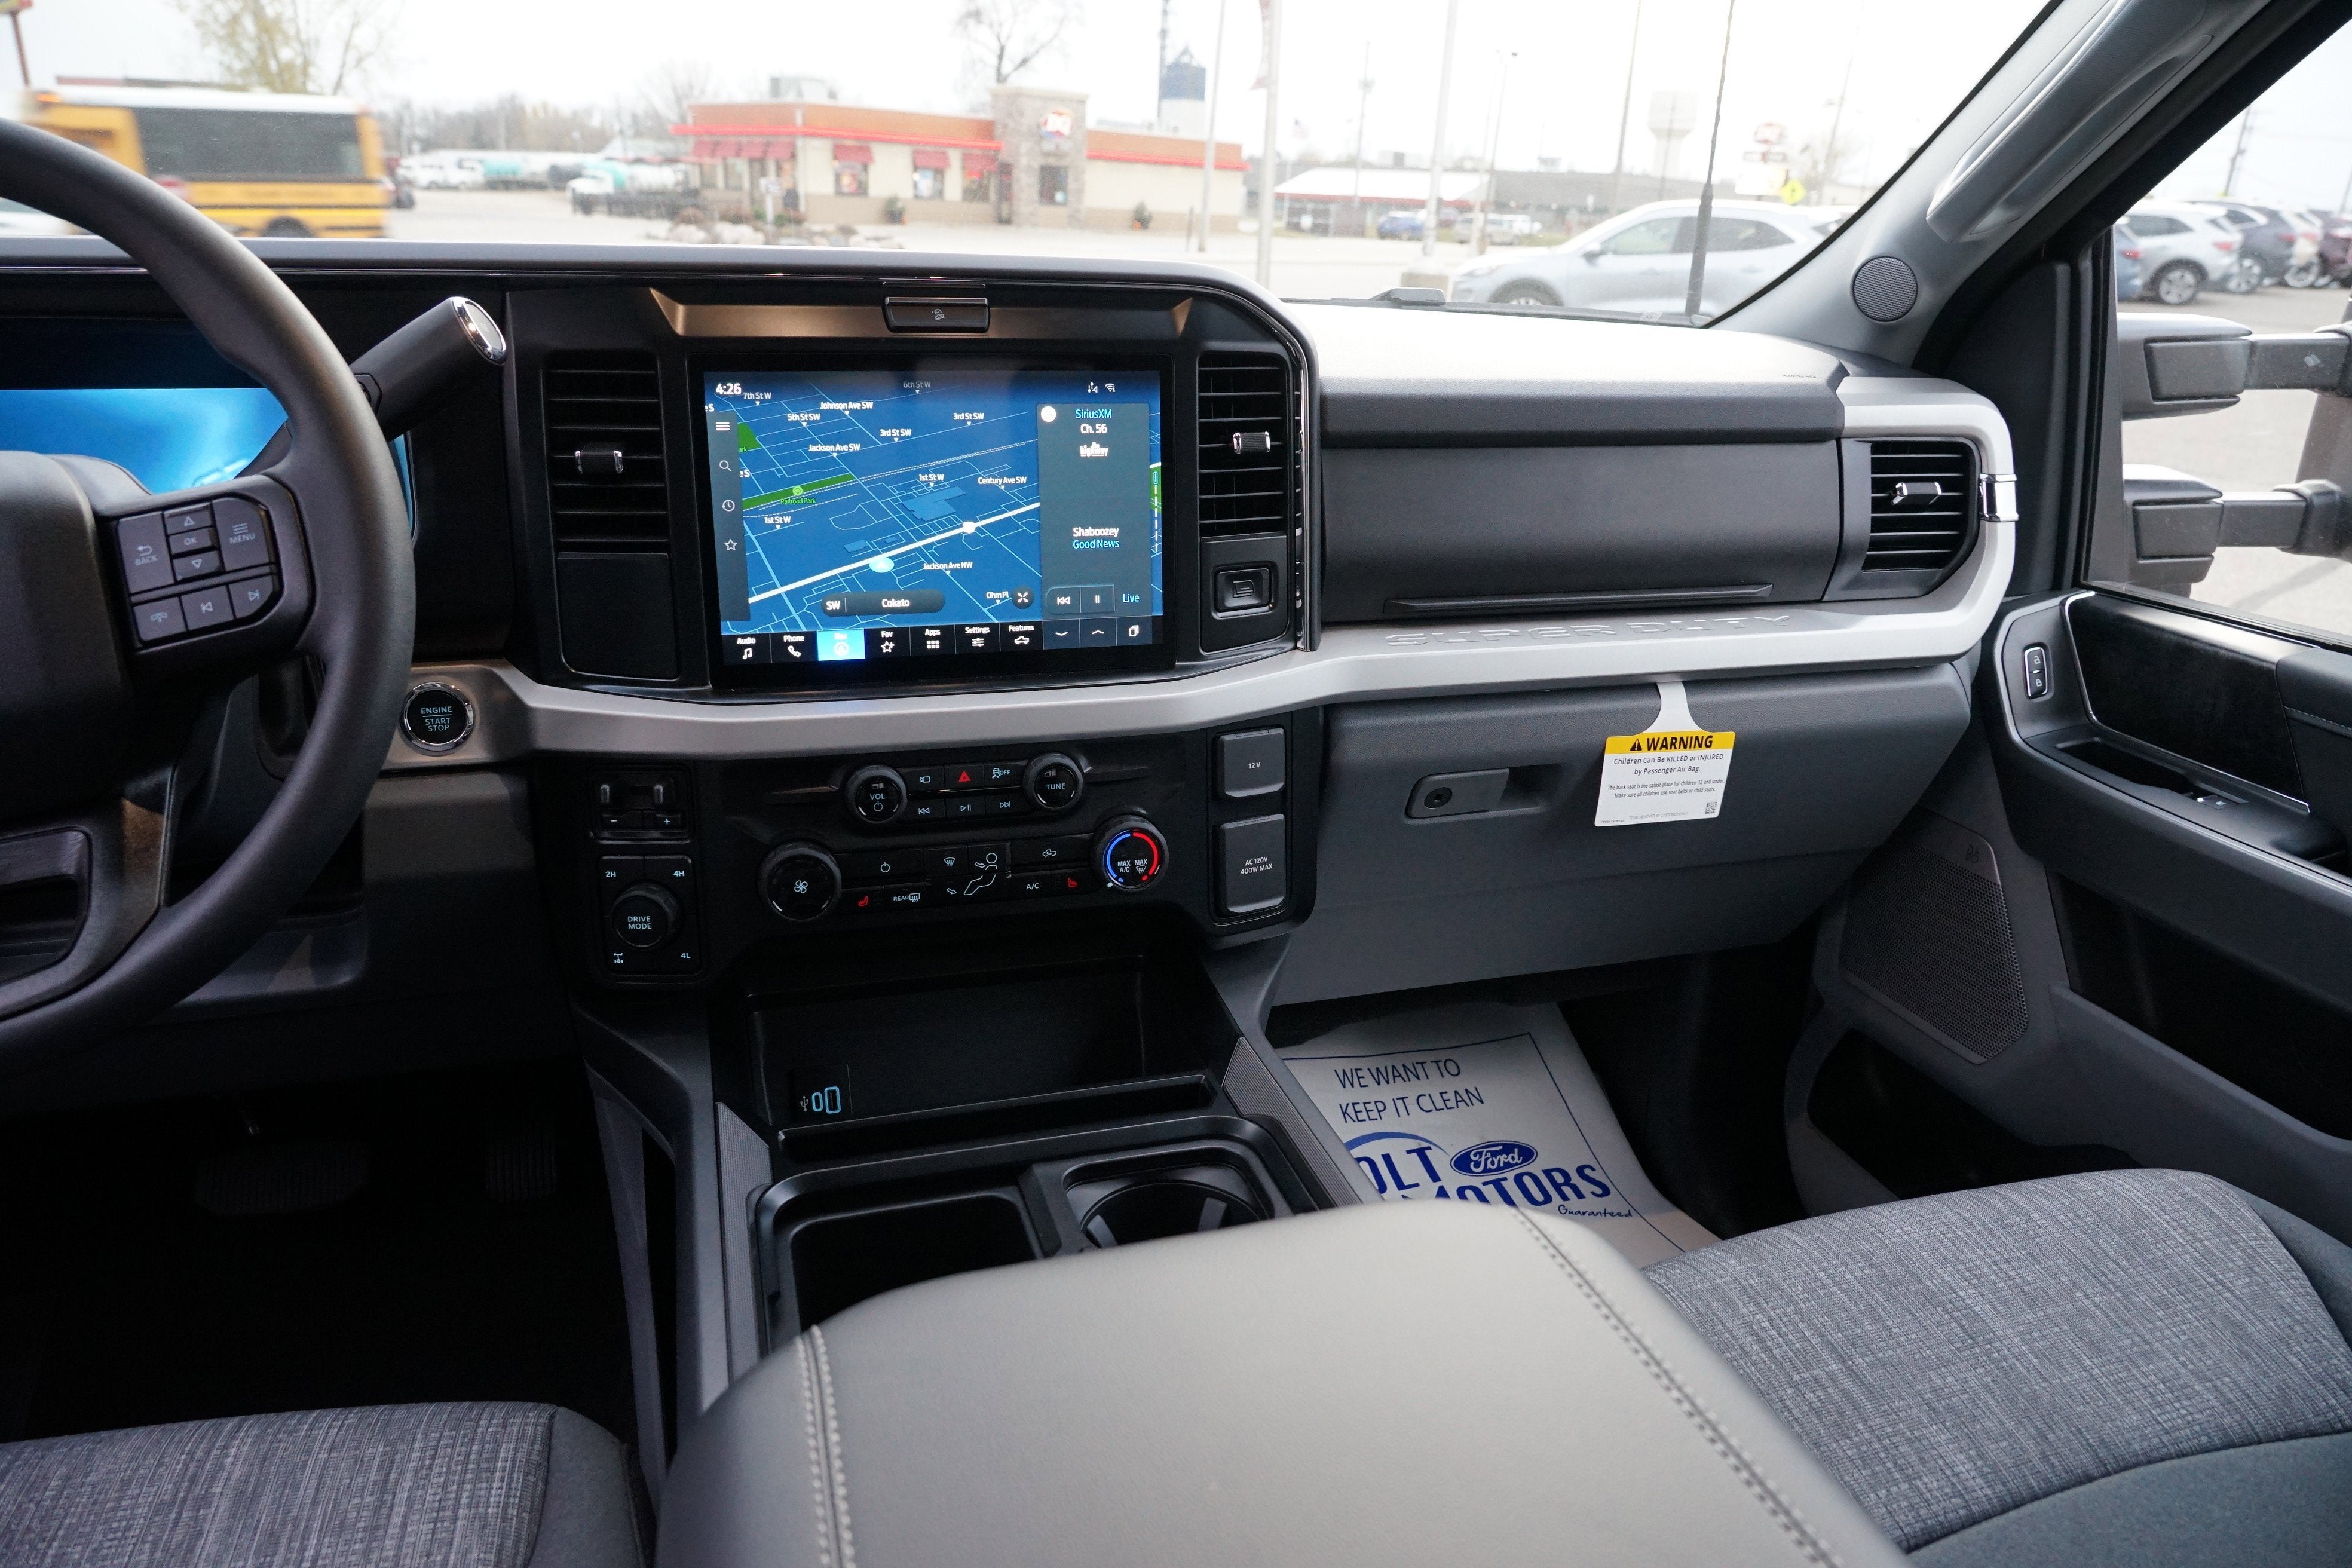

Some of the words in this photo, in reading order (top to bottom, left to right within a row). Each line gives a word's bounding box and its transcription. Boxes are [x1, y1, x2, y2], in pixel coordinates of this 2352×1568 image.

[715, 383, 742, 395] 4:26
[820, 402, 847, 410] Johnson
[1076, 409, 1112, 419] SiriusXM
[1080, 424, 1094, 433] Ch.
[1095, 424, 1107, 433] 56
[1073, 527, 1119, 537] Shaboozey
[229, 532, 256, 544] MENU
[1073, 540, 1095, 549] Good
[1097, 539, 1120, 549] News
[134, 555, 158, 566] BACK
[881, 599, 910, 608] Cokato
[1123, 594, 1140, 603] Live
[826, 601, 841, 610] SW
[1385, 624, 1616, 647] SUPER
[1626, 615, 1789, 634] DUTY
[1647, 735, 1713, 751] WARNING
[1698, 754, 1724, 762] INJURED
[1634, 768, 1642, 776] by
[1241, 866, 1258, 875] 400W
[1258, 863, 1273, 871] MAX
[1334, 1067, 1368, 1089] WE
[1368, 1061, 1429, 1086] WANT
[1430, 1058, 1461, 1078] TO
[1339, 1100, 1386, 1123] KEEP
[1392, 1096, 1410, 1117] IT
[1416, 1086, 1485, 1113] CLEAN
[1469, 1145, 1523, 1172] Ford
[1557, 1203, 1633, 1218] Guaranteed
